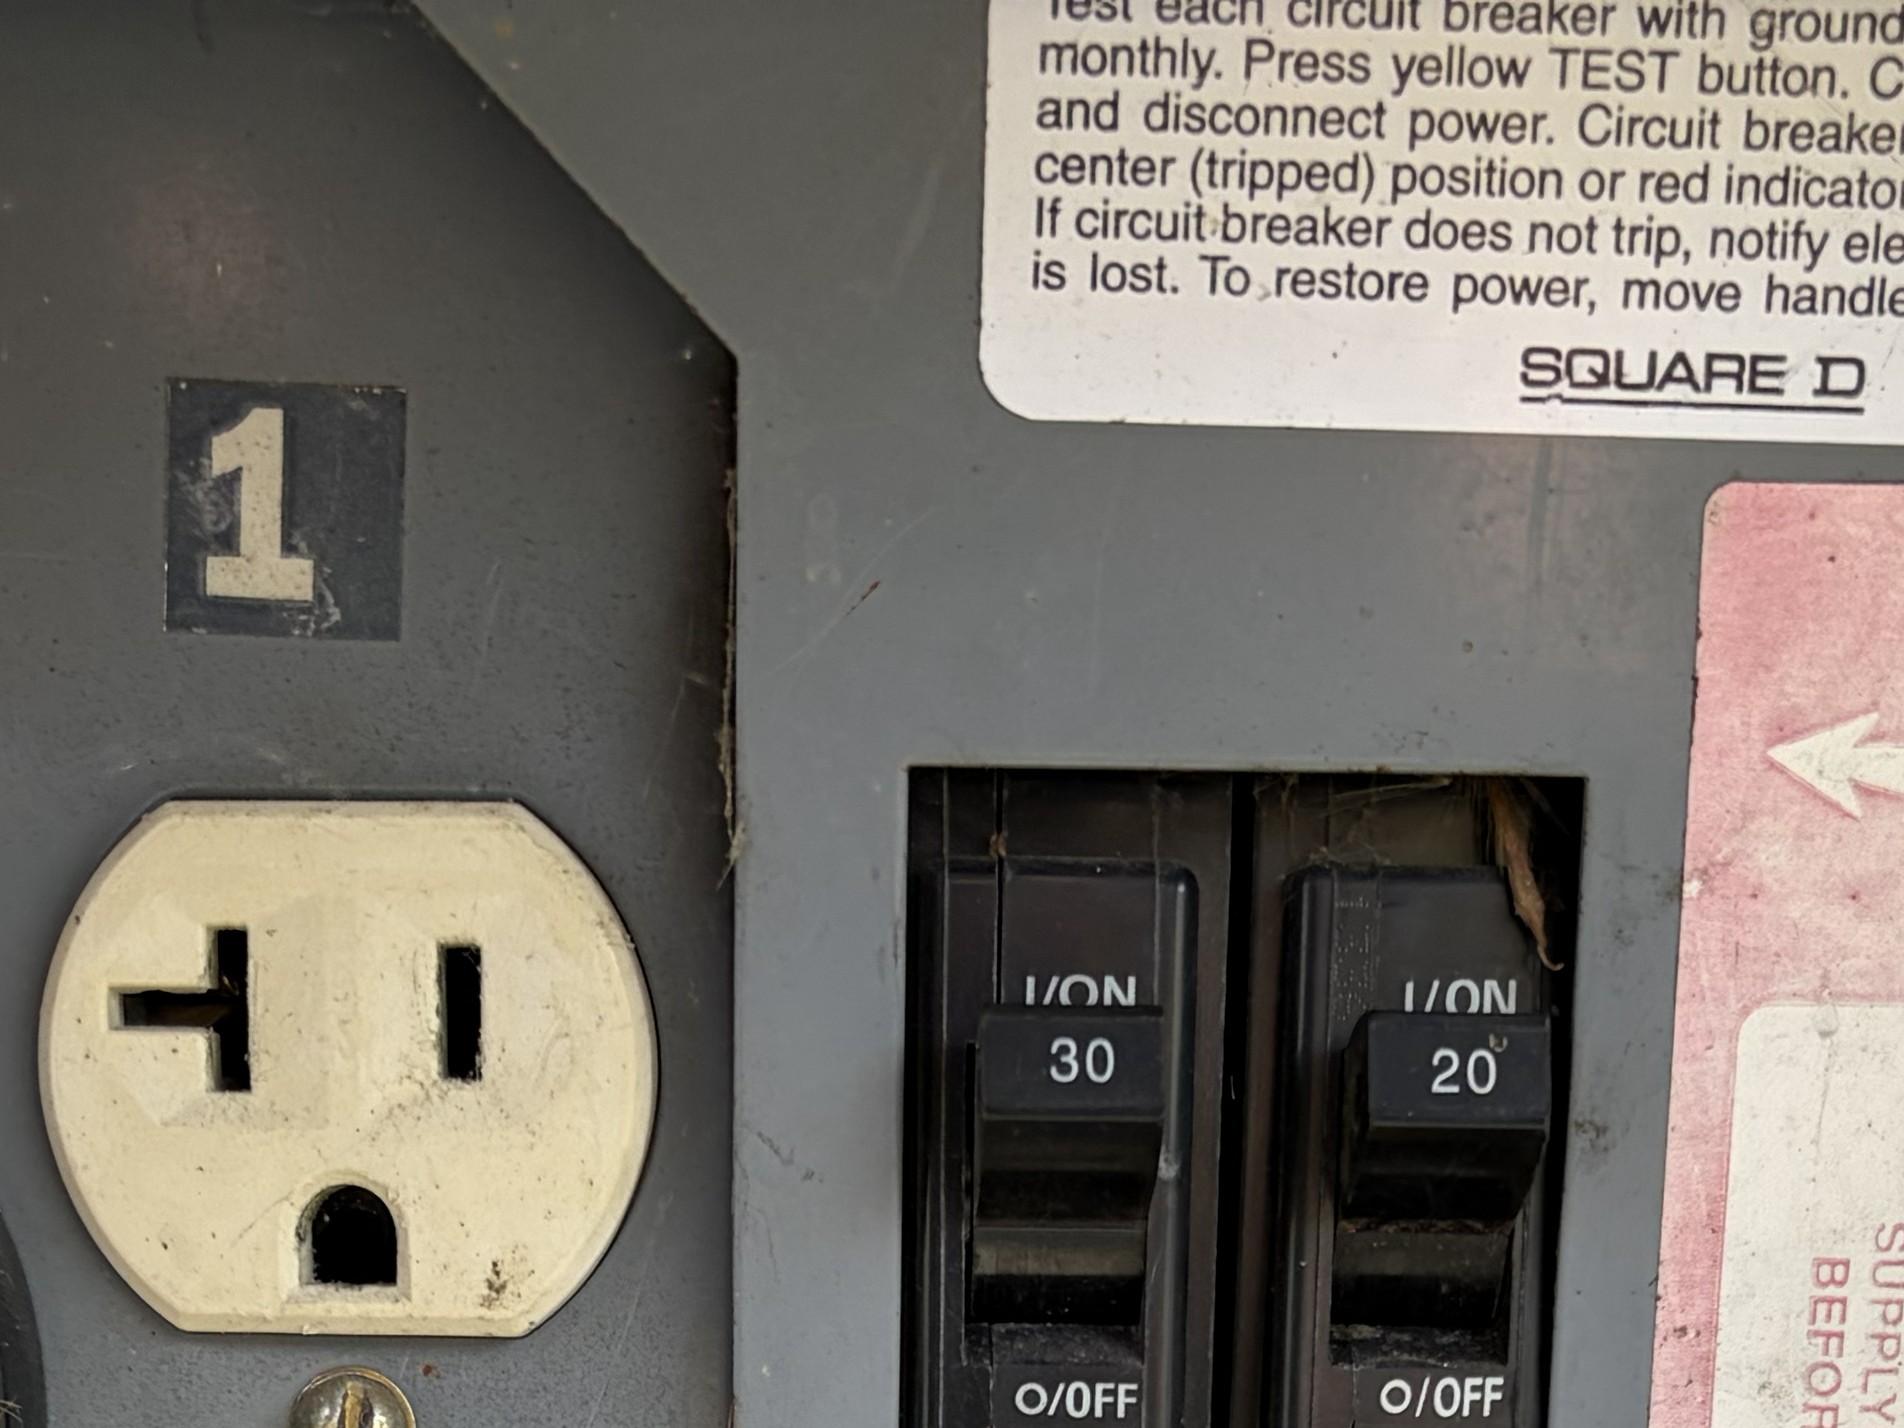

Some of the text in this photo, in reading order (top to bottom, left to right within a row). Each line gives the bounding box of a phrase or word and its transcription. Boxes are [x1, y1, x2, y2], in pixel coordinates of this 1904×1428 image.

[1287, 0, 1421, 31] circuit
[1444, 0, 1616, 36] breaker
[1637, 0, 1725, 39] with
[1040, 35, 1222, 90] monthly.
[1245, 38, 1371, 84] Press
[1391, 44, 1532, 97] yellow
[1549, 47, 1680, 93] TEST
[1698, 52, 1848, 99] button.
[1037, 89, 1119, 132] and
[1144, 91, 1387, 140] disconnect
[1409, 108, 1554, 152] power.
[1579, 102, 1721, 149] Circuit
[1035, 147, 1176, 187] center
[1191, 147, 1375, 204] (tripped)
[1391, 156, 1563, 206] position
[1579, 169, 1626, 201] or
[1639, 162, 1710, 204] red
[1036, 196, 1062, 238] If
[1075, 198, 1208, 243] circuit
[1220, 202, 1392, 248] breaker
[1405, 208, 1512, 252] does
[1529, 215, 1598, 254] not
[1612, 214, 1690, 268] trip,
[1710, 219, 1830, 273] notify
[1032, 250, 1066, 291] is
[1091, 251, 1178, 294] lost.
[1198, 254, 1251, 296] To
[1274, 262, 1429, 302] restore
[1452, 273, 1596, 316] power,
[1622, 278, 1741, 313] move
[1519, 345, 1867, 399] SQUARE D
[204, 405, 315, 601] 1
[1049, 1036, 1115, 1083] 30
[1431, 1046, 1497, 1095] 20
